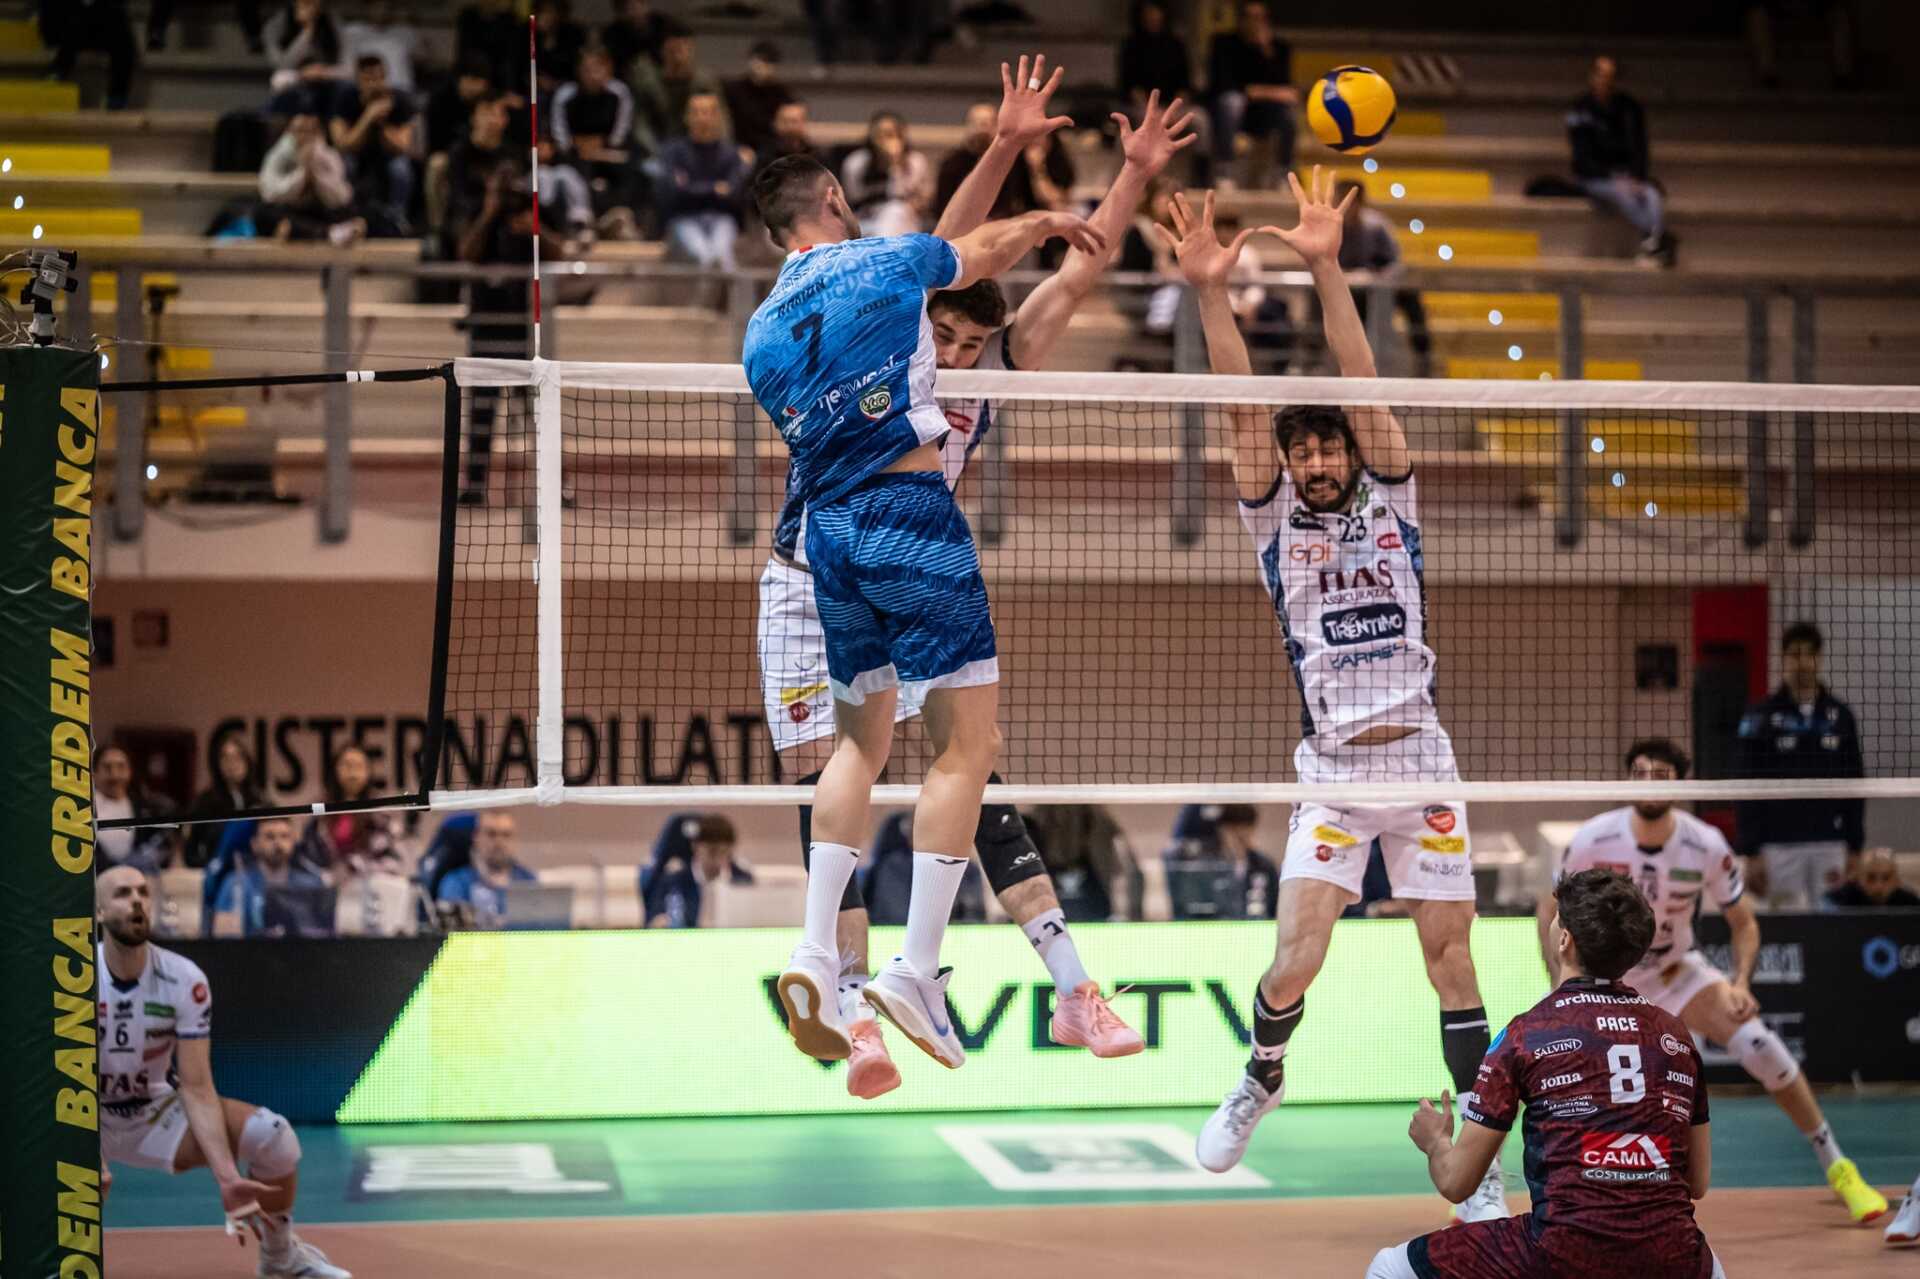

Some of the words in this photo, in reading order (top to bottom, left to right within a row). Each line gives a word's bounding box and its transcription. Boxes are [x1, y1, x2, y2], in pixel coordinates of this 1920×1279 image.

[791, 312, 824, 375] 7
[51, 387, 98, 601] BANCA
[1337, 515, 1367, 542] 23
[50, 628, 95, 874] CREDEM
[562, 714, 619, 787] DI
[52, 916, 98, 1132] BANCA
[115, 1022, 129, 1046] 6
[1596, 1016, 1639, 1032] PACE
[1534, 1040, 1577, 1059] SALVINI
[100, 1070, 149, 1095] TAS
[1606, 1044, 1647, 1104] 8
[1583, 1150, 1646, 1166] CAMI
